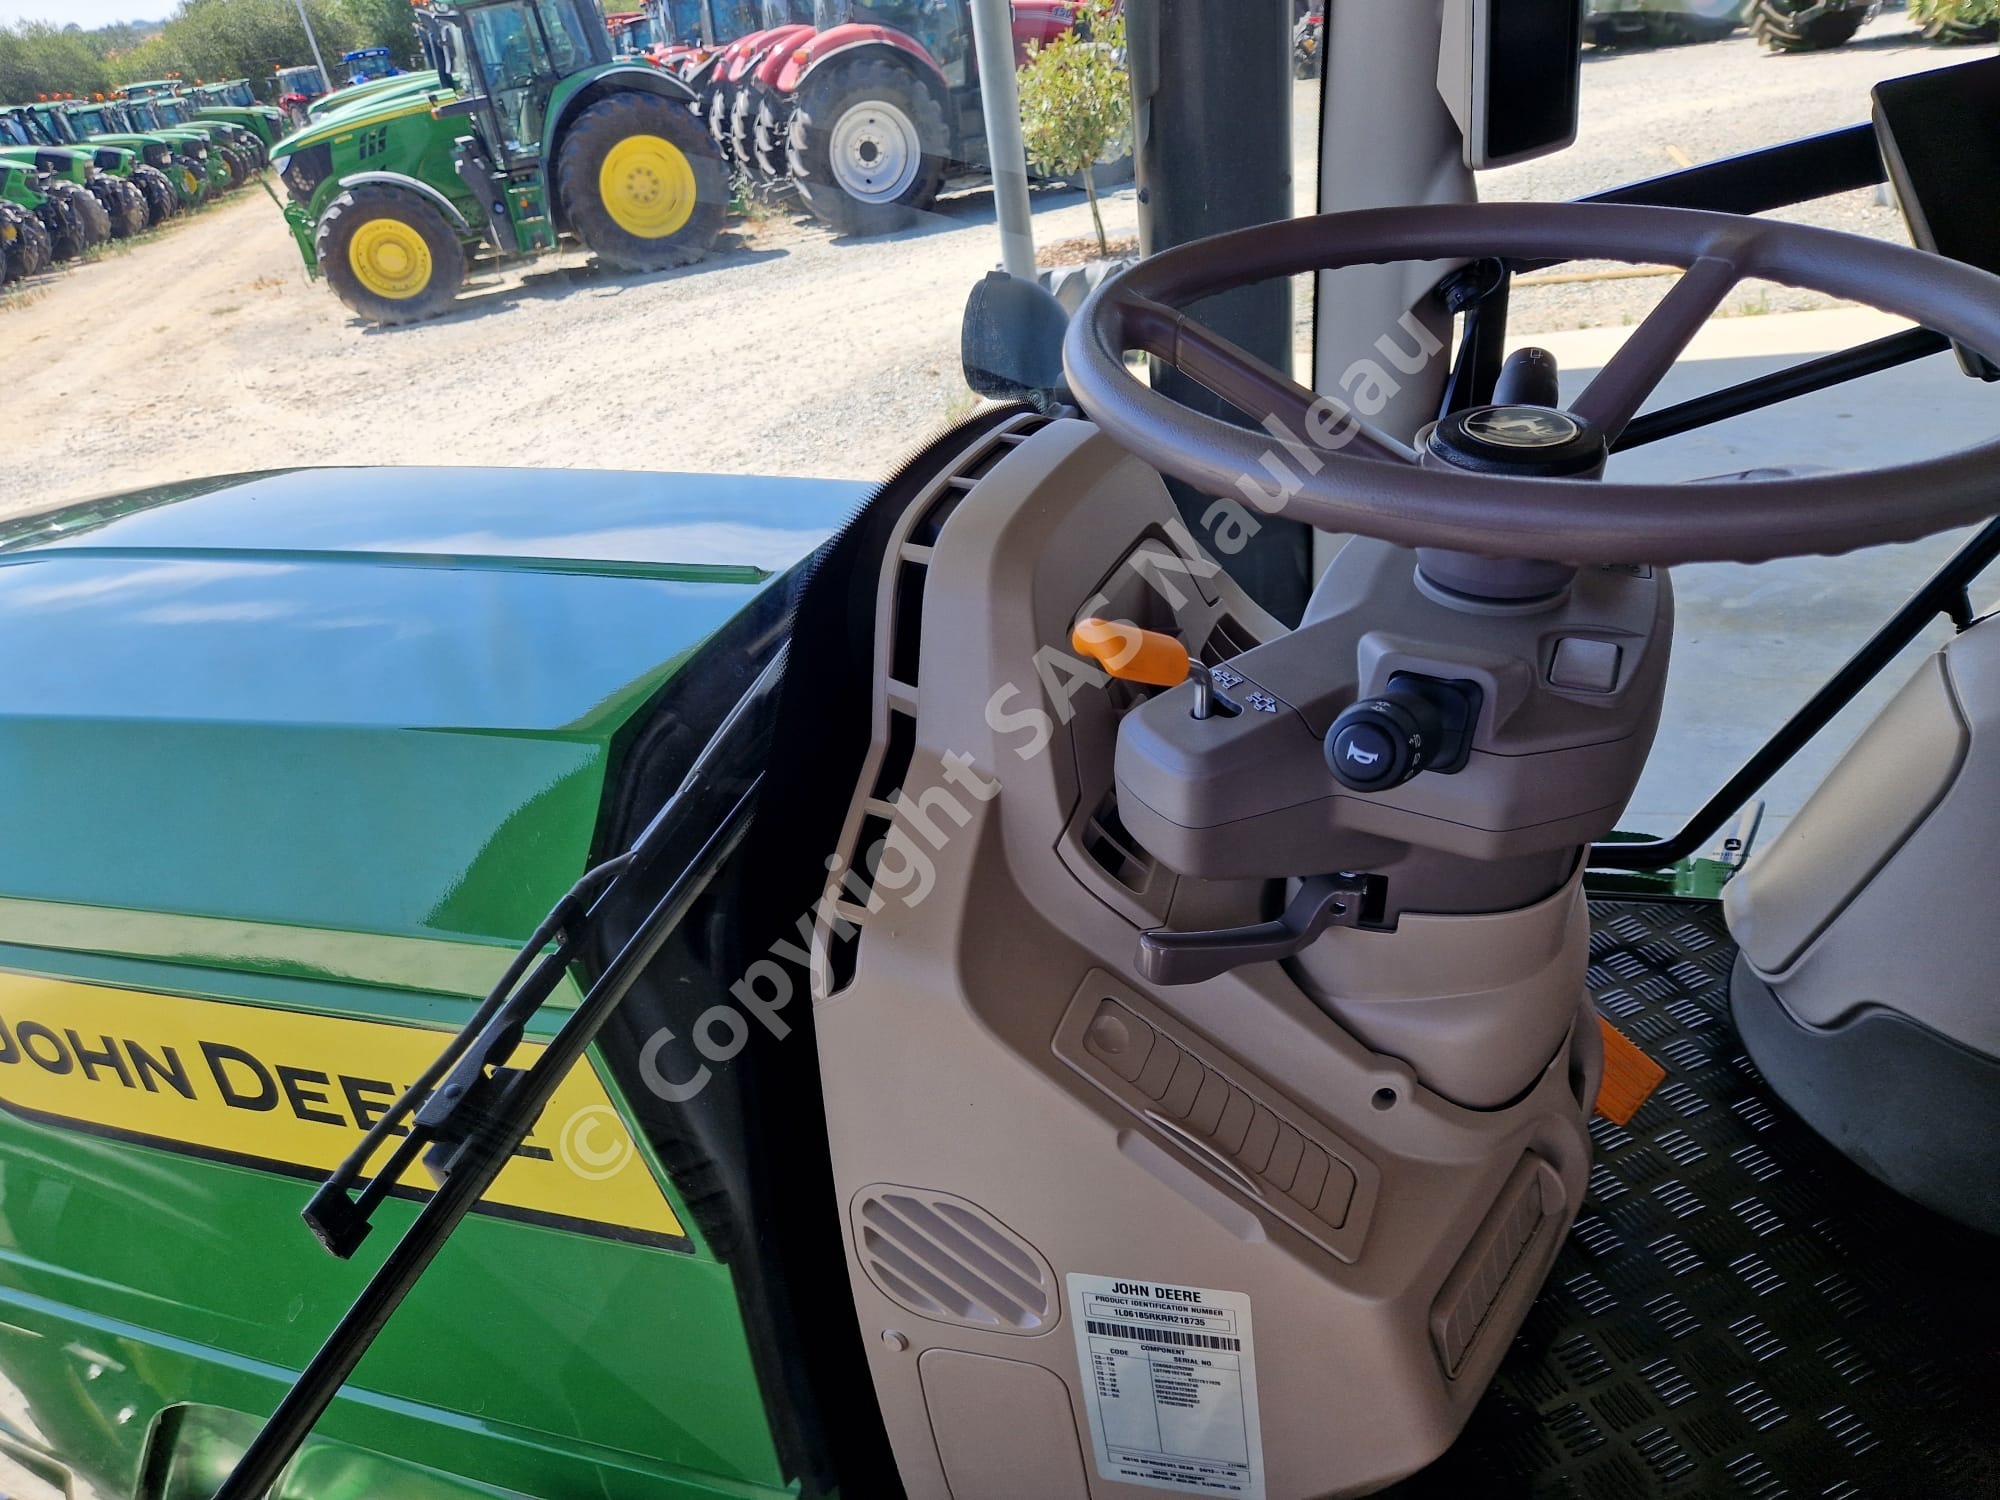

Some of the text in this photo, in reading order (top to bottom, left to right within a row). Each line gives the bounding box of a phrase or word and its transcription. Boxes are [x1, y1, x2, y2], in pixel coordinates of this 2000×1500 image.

[1112, 1282, 1202, 1303] JOHN DEERE
[1095, 1295, 1223, 1316] PRODUCT IDENTIFICATION NUMBER
[1140, 1344, 1185, 1356] COMPONENT
[1173, 1356, 1198, 1365] SERIAL
